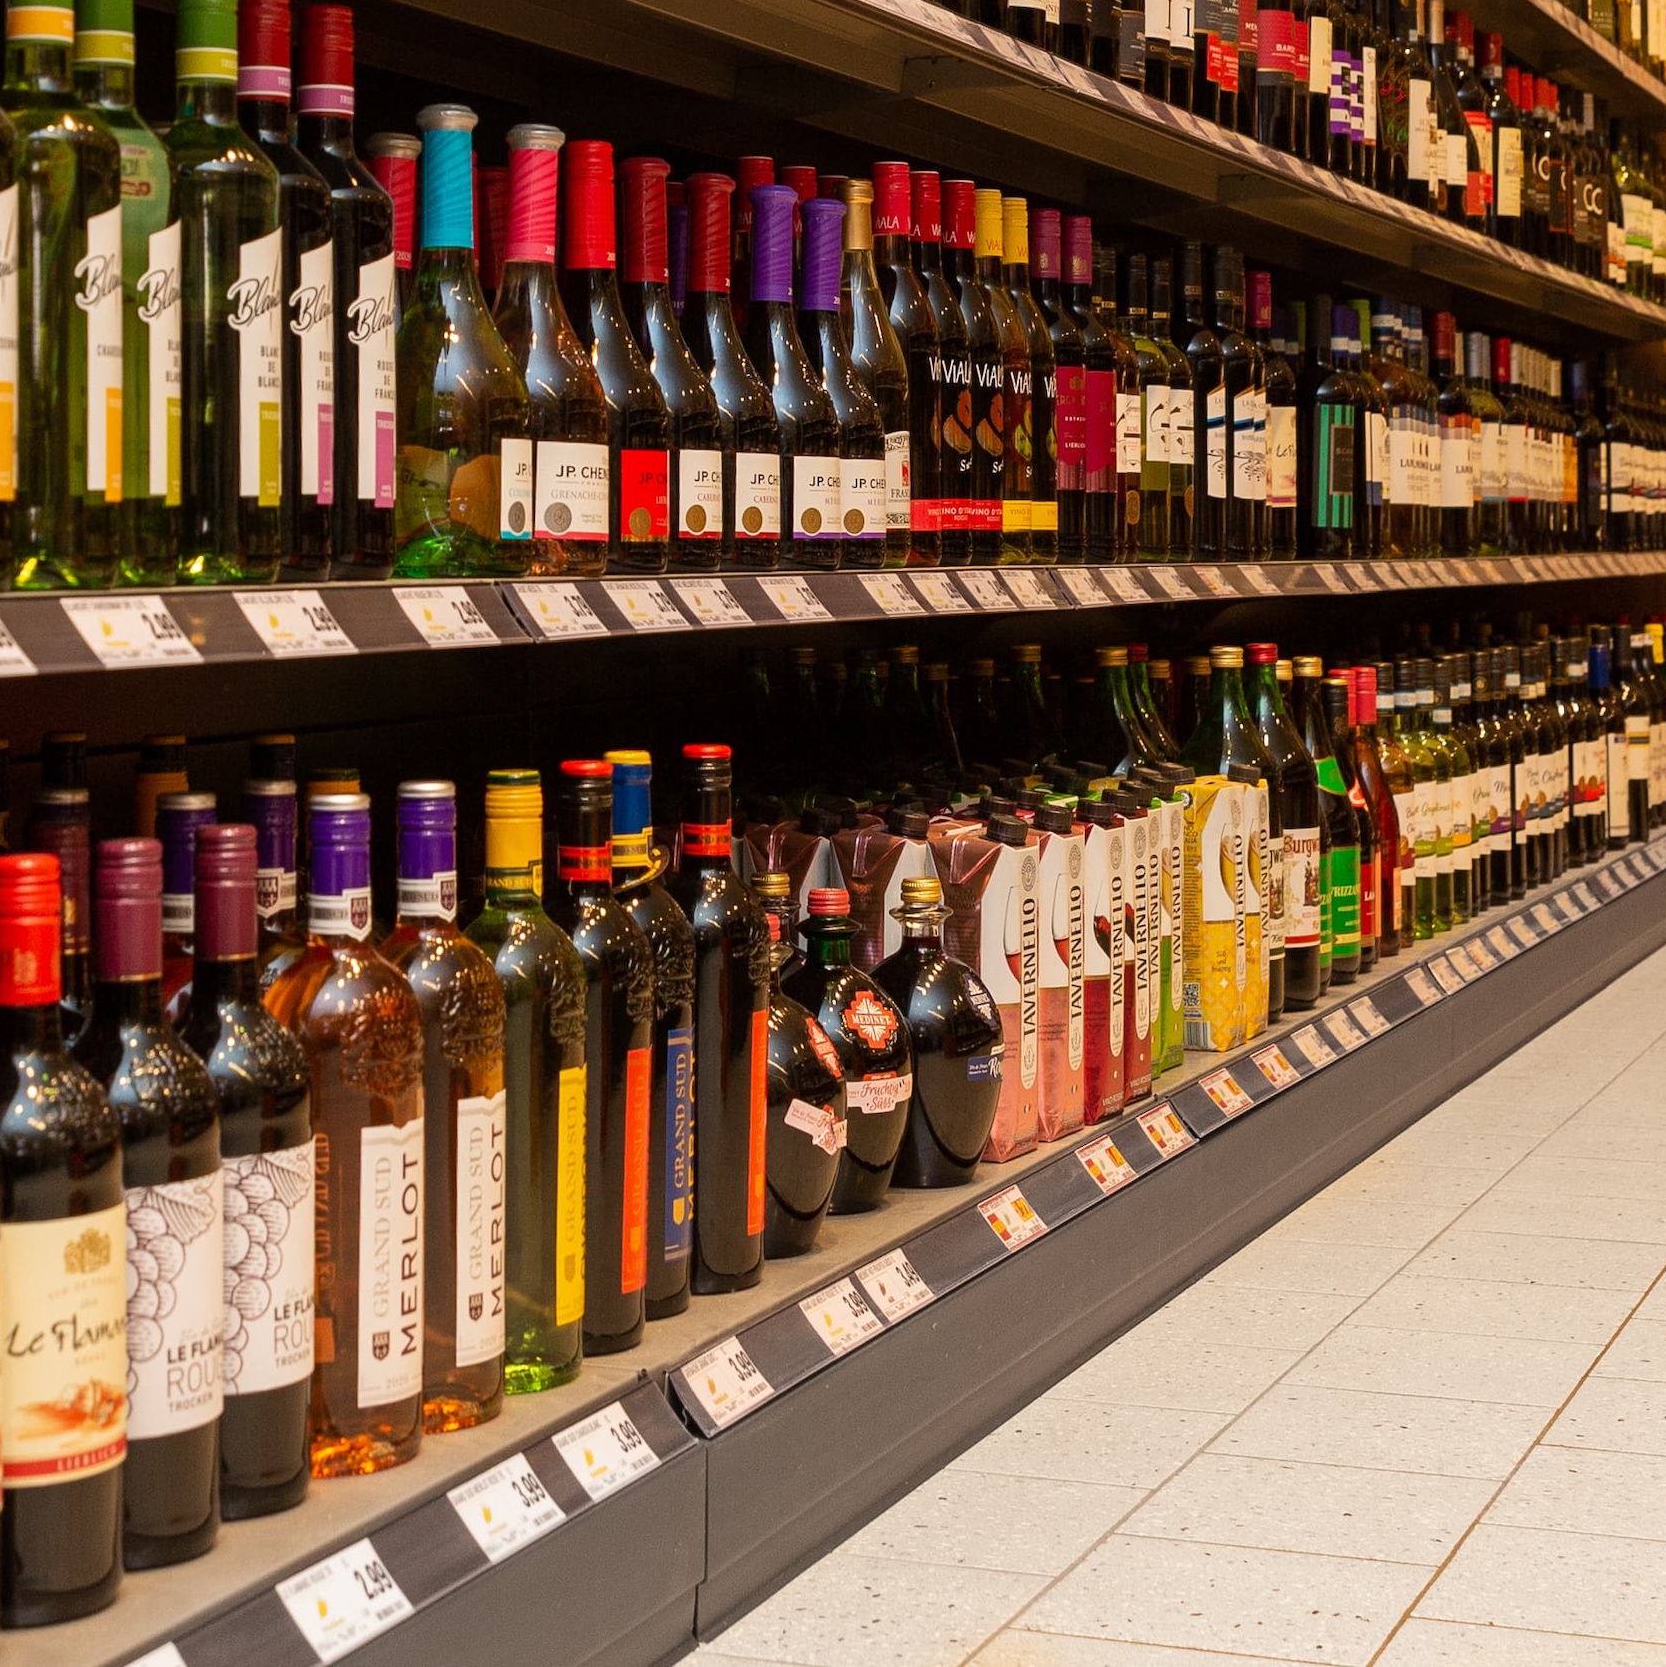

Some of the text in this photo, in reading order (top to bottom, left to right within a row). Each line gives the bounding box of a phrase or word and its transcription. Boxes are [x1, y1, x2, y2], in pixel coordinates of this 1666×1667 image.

[555, 465, 577, 479] JP.
[694, 470, 710, 483] JP.
[750, 472, 766, 485] JP.
[809, 475, 825, 487] JP.
[851, 477, 867, 489] JP.
[141, 610, 182, 642] 2.99
[302, 604, 338, 633] 2.99
[1149, 853, 1160, 976] TAVERNELLO
[1171, 845, 1182, 964] TAVERNELLO
[1111, 875, 1124, 1011] TAVERNELLO
[1134, 863, 1148, 991] TAVERNELLO
[1022, 897, 1037, 1036] TAVERNELLO
[1069, 885, 1083, 1020] TAVERNELLO
[851, 1013, 893, 1026] MEDINET
[673, 1051, 688, 1190] GRAND SUD
[564, 1093, 578, 1244] GRAND SUD
[468, 1125, 485, 1281] GRAND SUD
[490, 1121, 505, 1319] MERLOT
[372, 1155, 393, 1319] GRAND SUD
[399, 1152, 421, 1357] MERLOT
[274, 1306, 291, 1322] LE
[167, 1345, 187, 1364] LE
[276, 1347, 311, 1369] TROCKEN
[729, 1350, 763, 1383] 3.99
[169, 1392, 214, 1414] TROCKEN
[611, 1420, 643, 1453] 3.99
[512, 1473, 546, 1508] 3.99
[353, 1560, 393, 1602] 2.99
